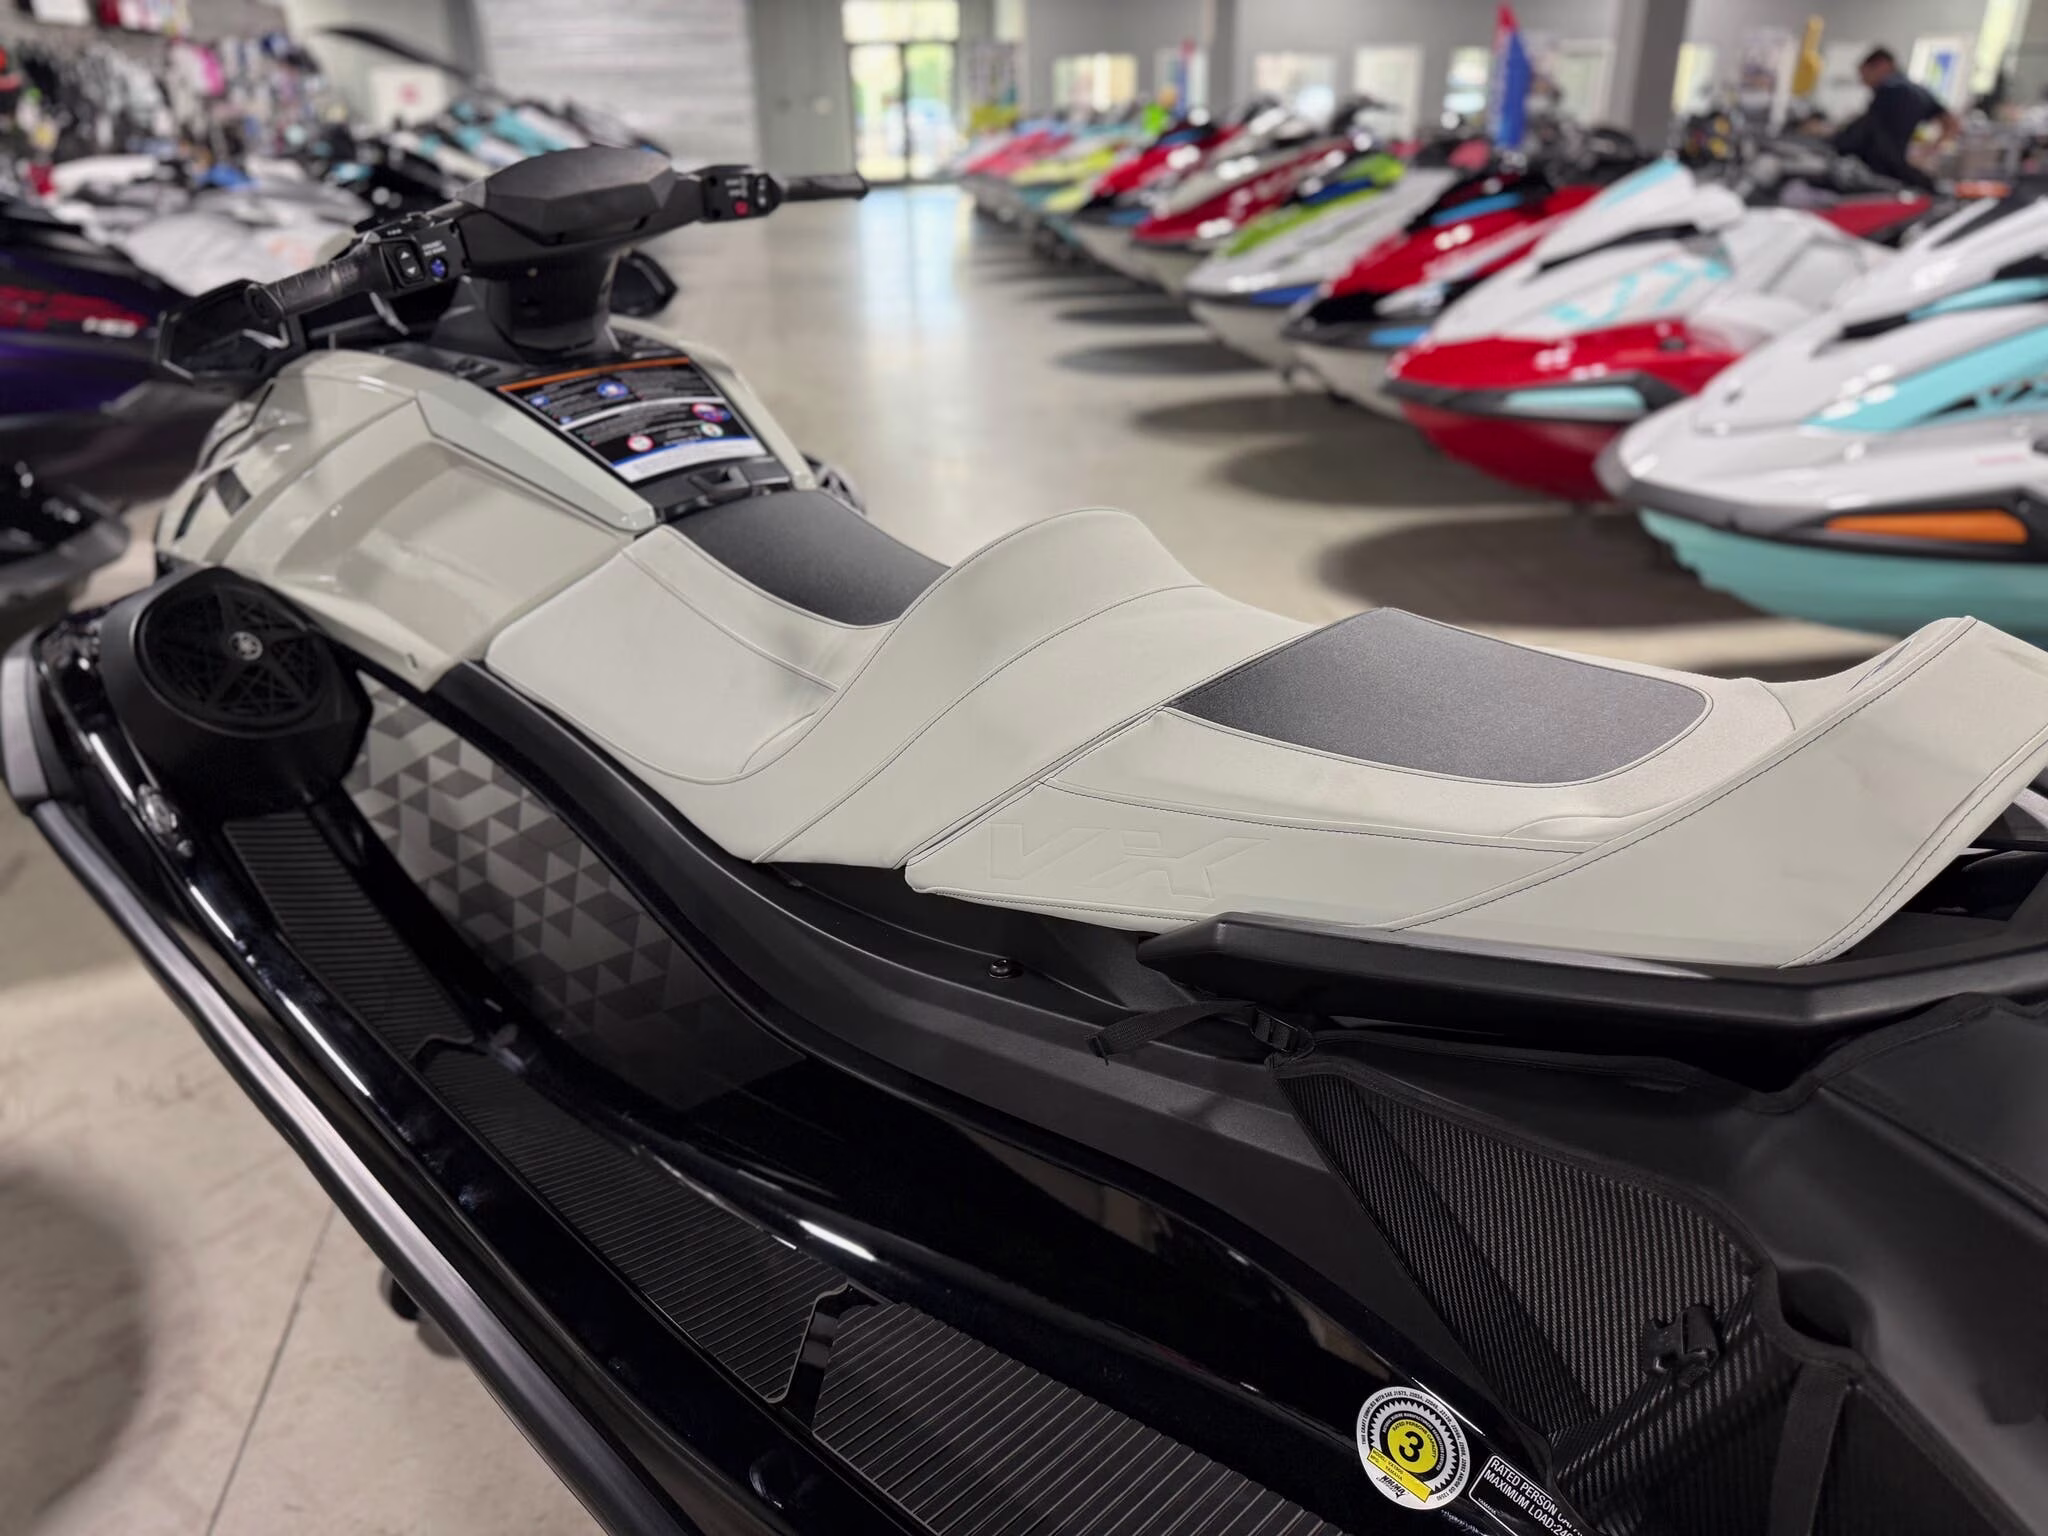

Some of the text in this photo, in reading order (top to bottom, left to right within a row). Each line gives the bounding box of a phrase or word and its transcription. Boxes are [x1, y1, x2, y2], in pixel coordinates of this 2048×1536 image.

[988, 822, 1271, 900] VX
[1362, 1400, 1376, 1419] COMPLIES
[1374, 1393, 1384, 1402] WITH
[1391, 1420, 1436, 1458] RATED PERSONS CAPACITY
[1398, 1431, 1424, 1462] 3
[1484, 1470, 1530, 1510] MAXIMUM
[1528, 1504, 1574, 1536] LOAD:24
[1490, 1459, 1558, 1516] RATED PERSON
